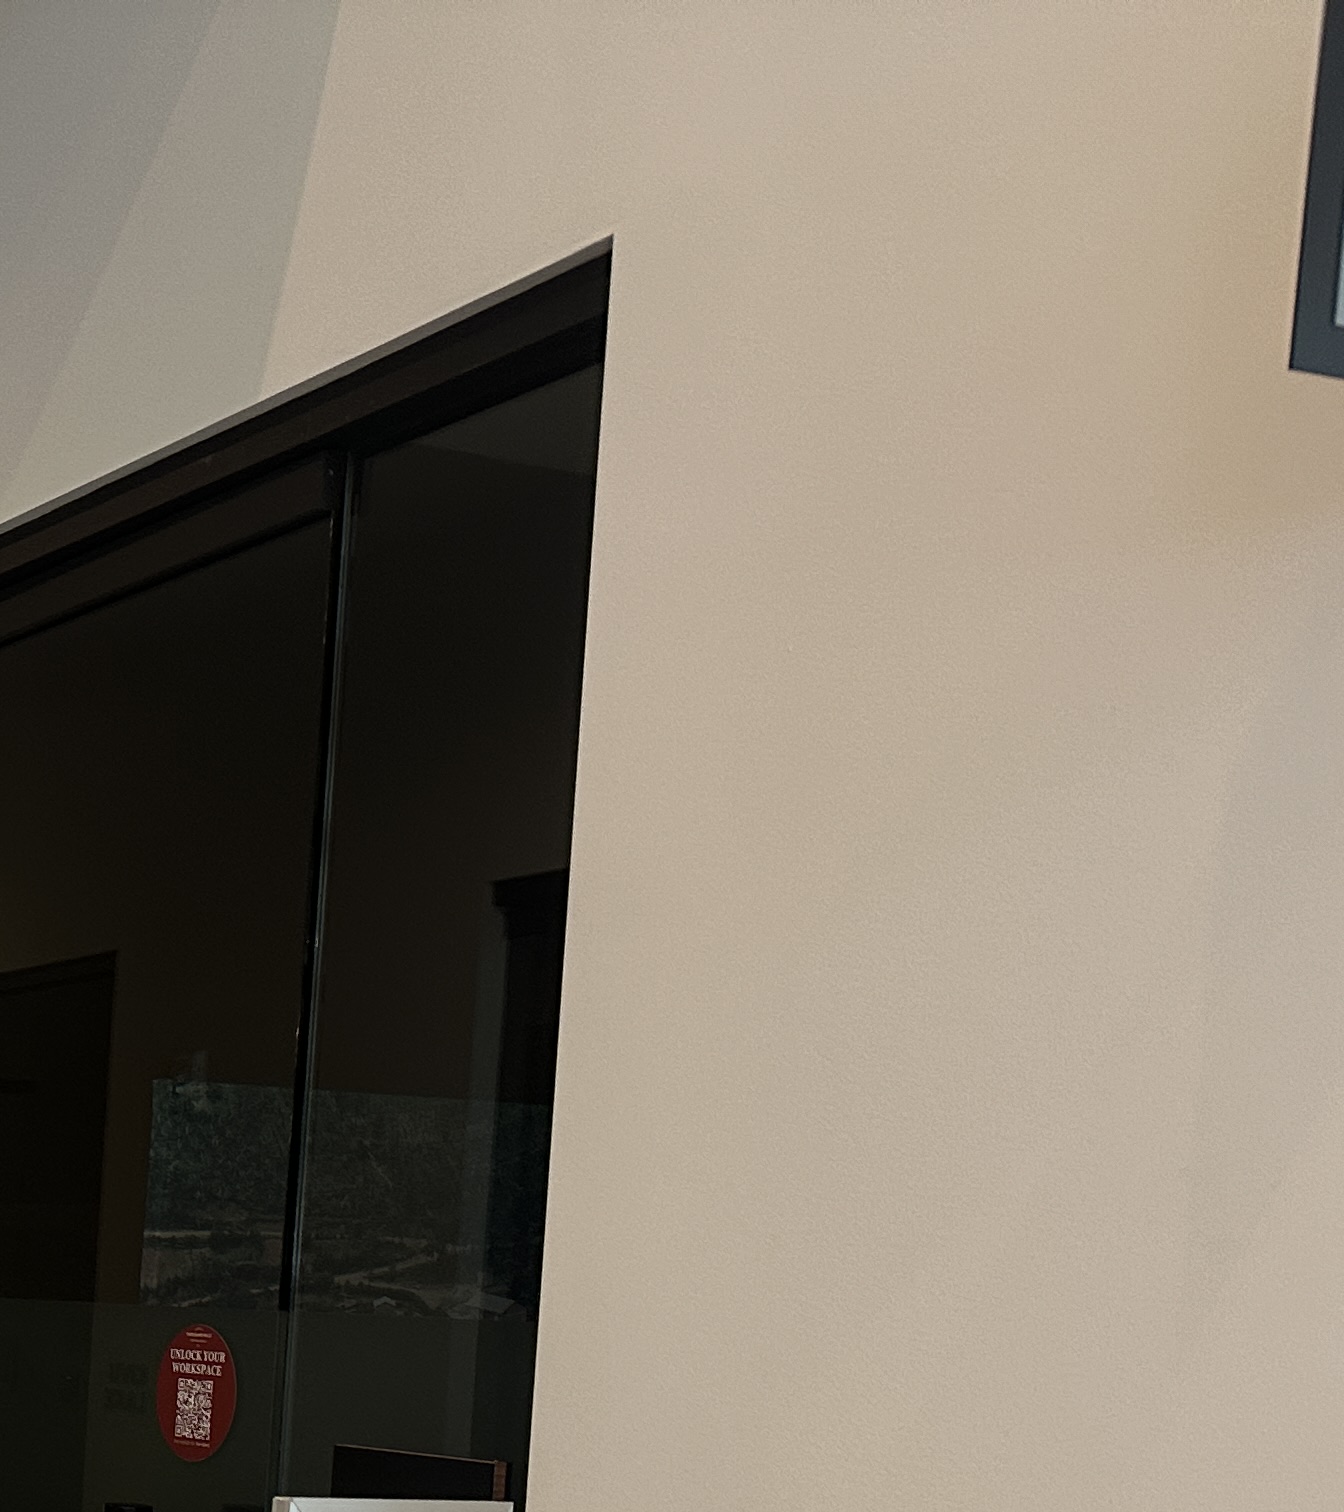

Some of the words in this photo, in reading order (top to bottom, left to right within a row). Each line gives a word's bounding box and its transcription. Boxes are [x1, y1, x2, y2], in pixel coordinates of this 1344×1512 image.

[170, 1349, 203, 1362] UNLOCK
[203, 1351, 226, 1364] YOUR
[172, 1362, 223, 1377] WORKSPACE
